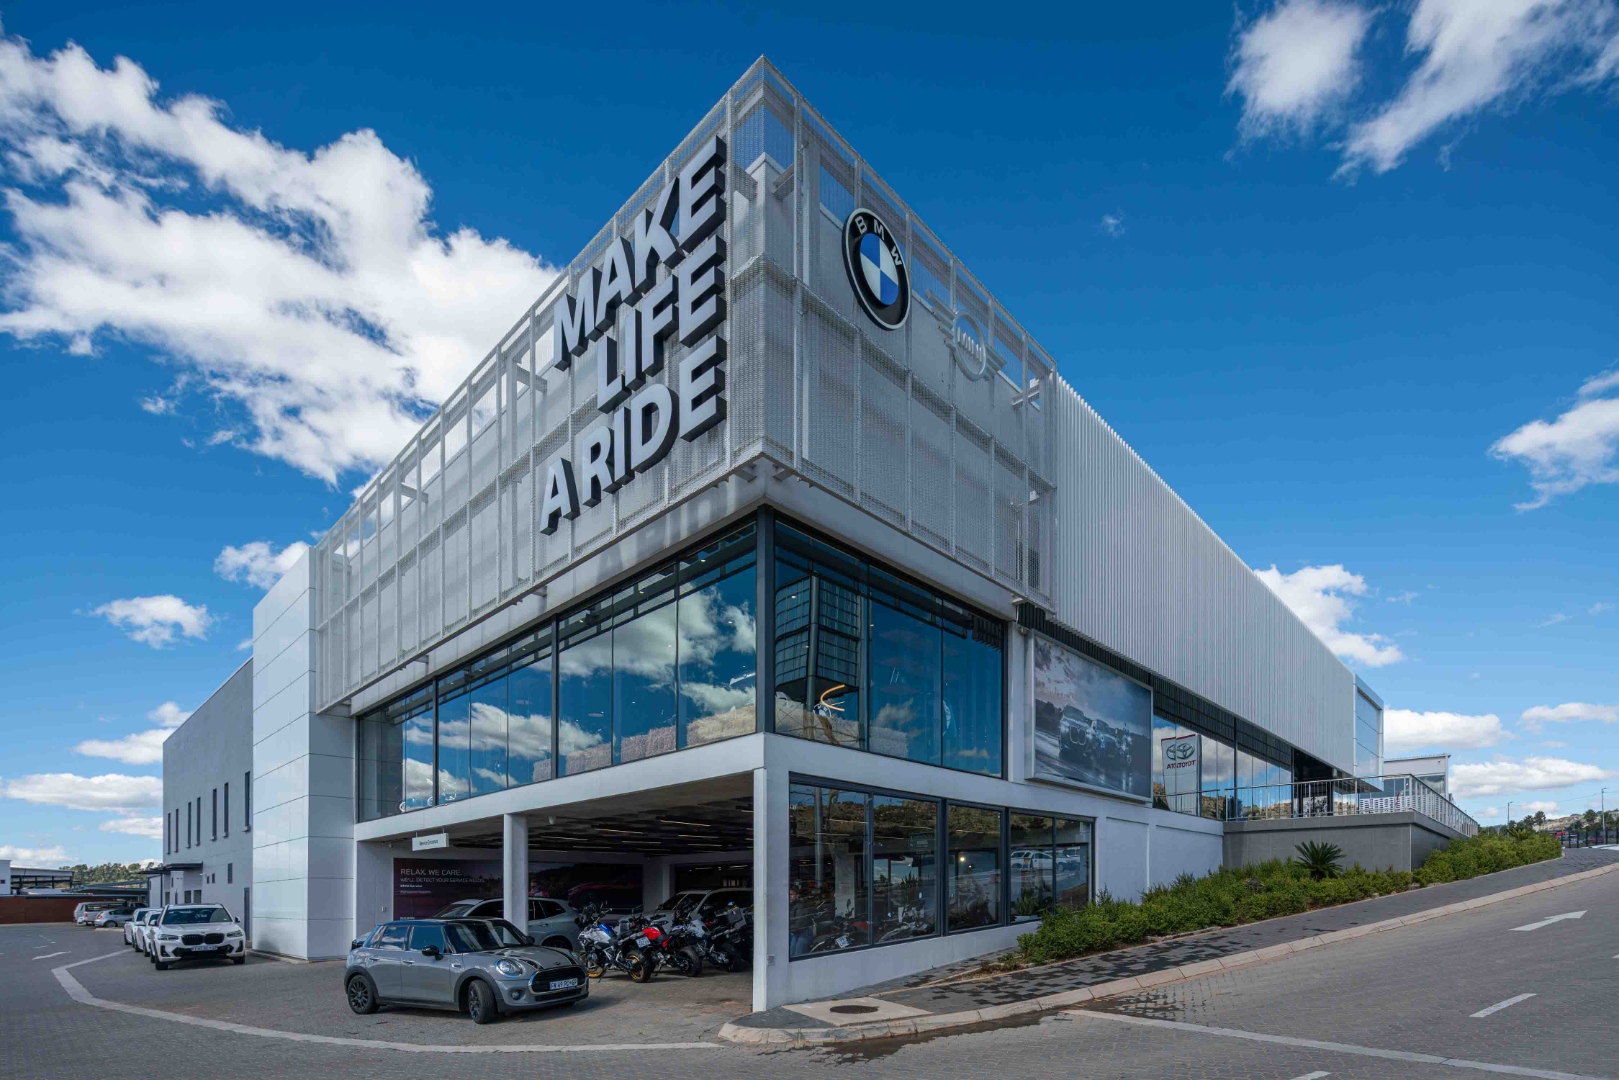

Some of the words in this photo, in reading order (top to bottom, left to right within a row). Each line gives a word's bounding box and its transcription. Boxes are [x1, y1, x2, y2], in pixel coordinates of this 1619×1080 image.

[553, 135, 727, 371] MAKE
[598, 234, 727, 414] LIFE
[855, 215, 902, 266] BMW
